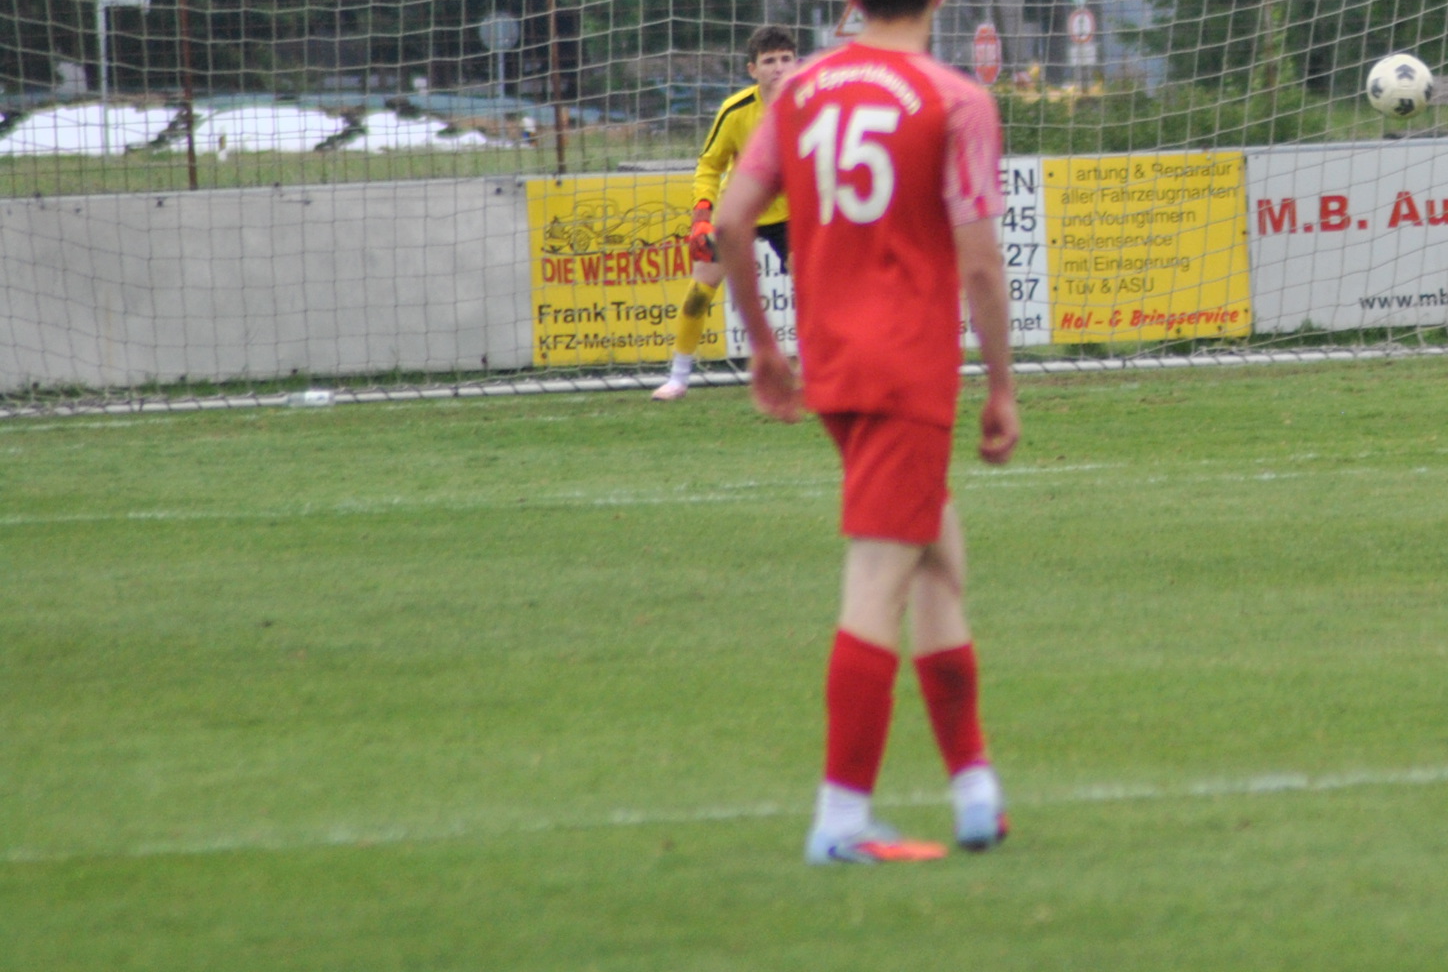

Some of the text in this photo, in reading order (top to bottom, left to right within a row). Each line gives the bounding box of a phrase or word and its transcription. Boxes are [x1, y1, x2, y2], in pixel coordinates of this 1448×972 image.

[798, 103, 900, 227] 15
[1061, 188, 1096, 205] aller
[1257, 195, 1369, 236] M.B.
[1002, 244, 1039, 267] 27
[1064, 258, 1088, 273] mit
[542, 257, 576, 284] DIE
[1118, 276, 1155, 293] ASU
[538, 302, 606, 325] Frank
[1130, 306, 1240, 332] Bringservice
